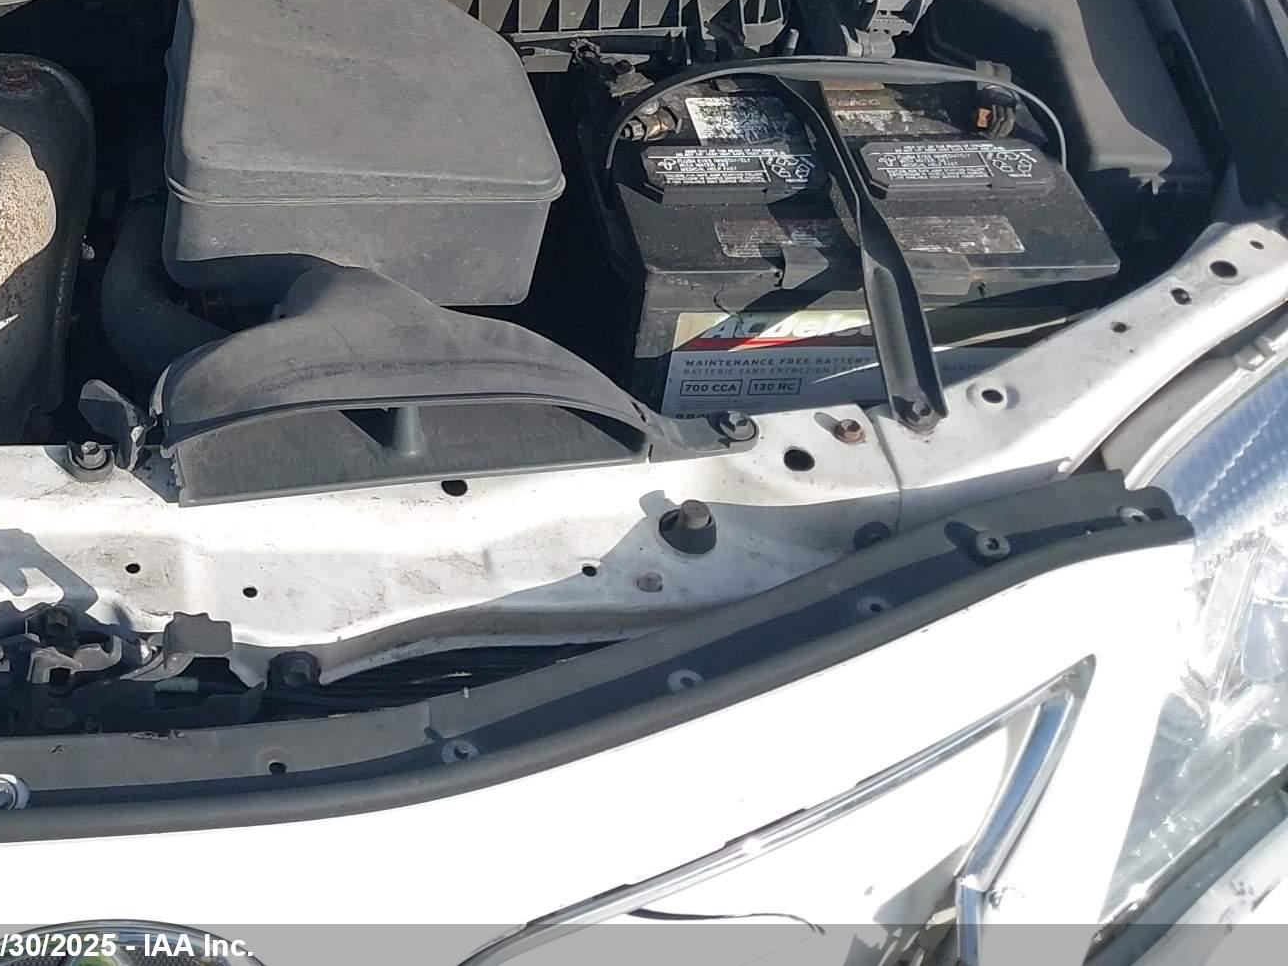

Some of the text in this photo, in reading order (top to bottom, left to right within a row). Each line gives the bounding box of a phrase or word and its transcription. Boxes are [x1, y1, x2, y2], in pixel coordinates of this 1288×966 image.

[685, 358, 775, 367] MAINTENANCE
[685, 384, 737, 392] 700 CCA
[753, 382, 797, 391] 130 RC
